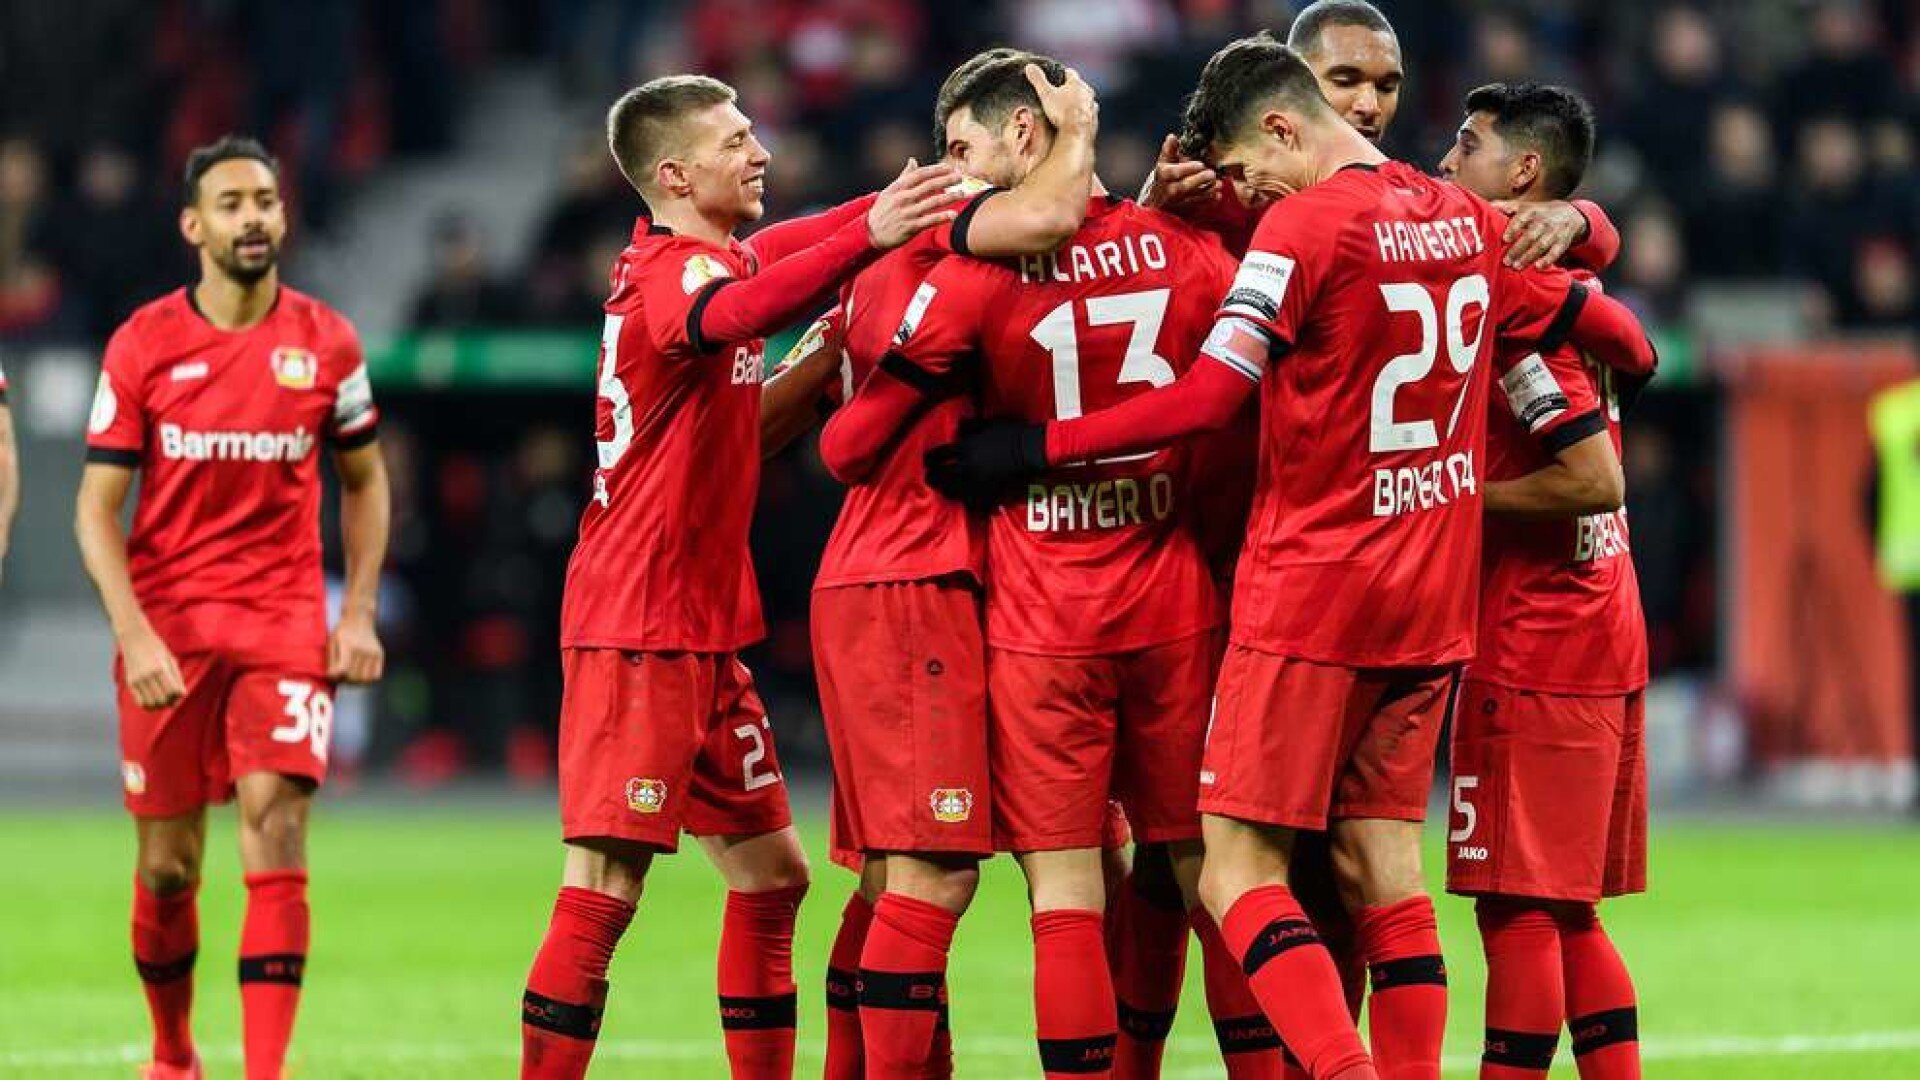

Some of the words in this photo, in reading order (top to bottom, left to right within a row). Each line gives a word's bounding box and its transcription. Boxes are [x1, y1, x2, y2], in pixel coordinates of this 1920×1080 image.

[1373, 216, 1484, 262] HAVERTZ
[596, 314, 635, 468] 3
[1029, 288, 1176, 466] 13
[1369, 273, 1490, 453] 29
[1027, 478, 1141, 532] BAYER
[1150, 472, 1175, 521] 0
[271, 679, 334, 766] 38
[733, 715, 783, 792] 2
[1458, 846, 1488, 860] JAKO
